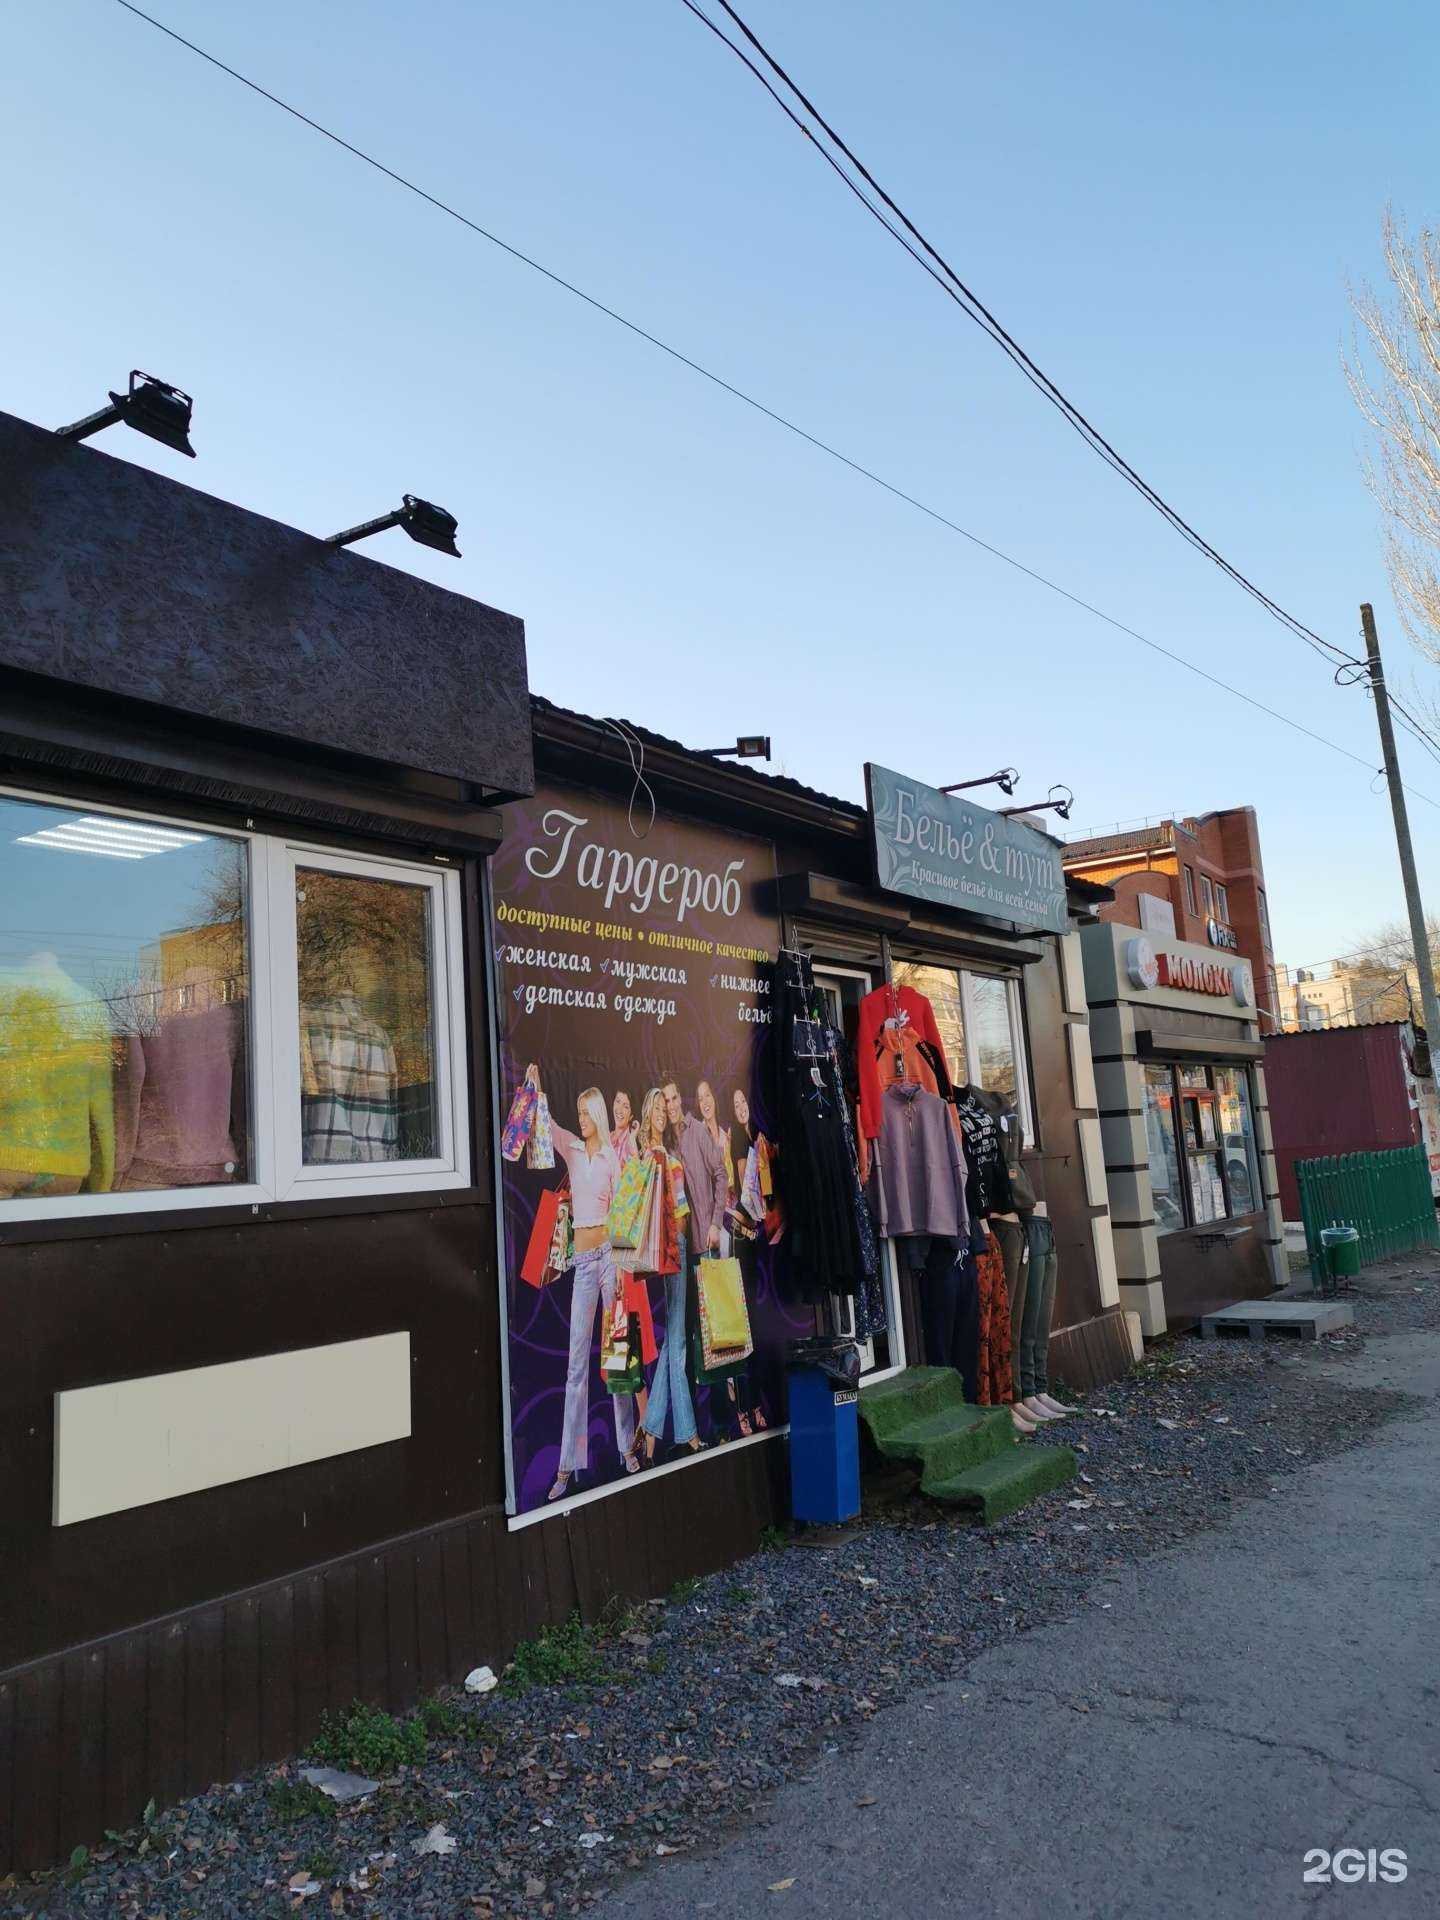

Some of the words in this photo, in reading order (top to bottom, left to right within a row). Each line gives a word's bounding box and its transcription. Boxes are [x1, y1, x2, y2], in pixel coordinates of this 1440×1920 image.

[525, 809, 745, 922] Гардероб
[896, 788, 975, 865] Бельё
[979, 822, 1001, 874] &
[1005, 844, 1054, 897] тут
[911, 859, 959, 889] Красивое
[960, 875, 986, 898] бельё
[987, 884, 1004, 904] для
[1005, 891, 1025, 909] всей
[497, 899, 591, 933] доступные
[595, 921, 633, 942] цены
[648, 930, 713, 954] отличное
[716, 942, 769, 963] качество
[506, 945, 592, 973] женская
[611, 959, 688, 988] мужская
[720, 974, 770, 994] нижнее
[525, 984, 607, 1014] детская
[614, 994, 677, 1025] одежда
